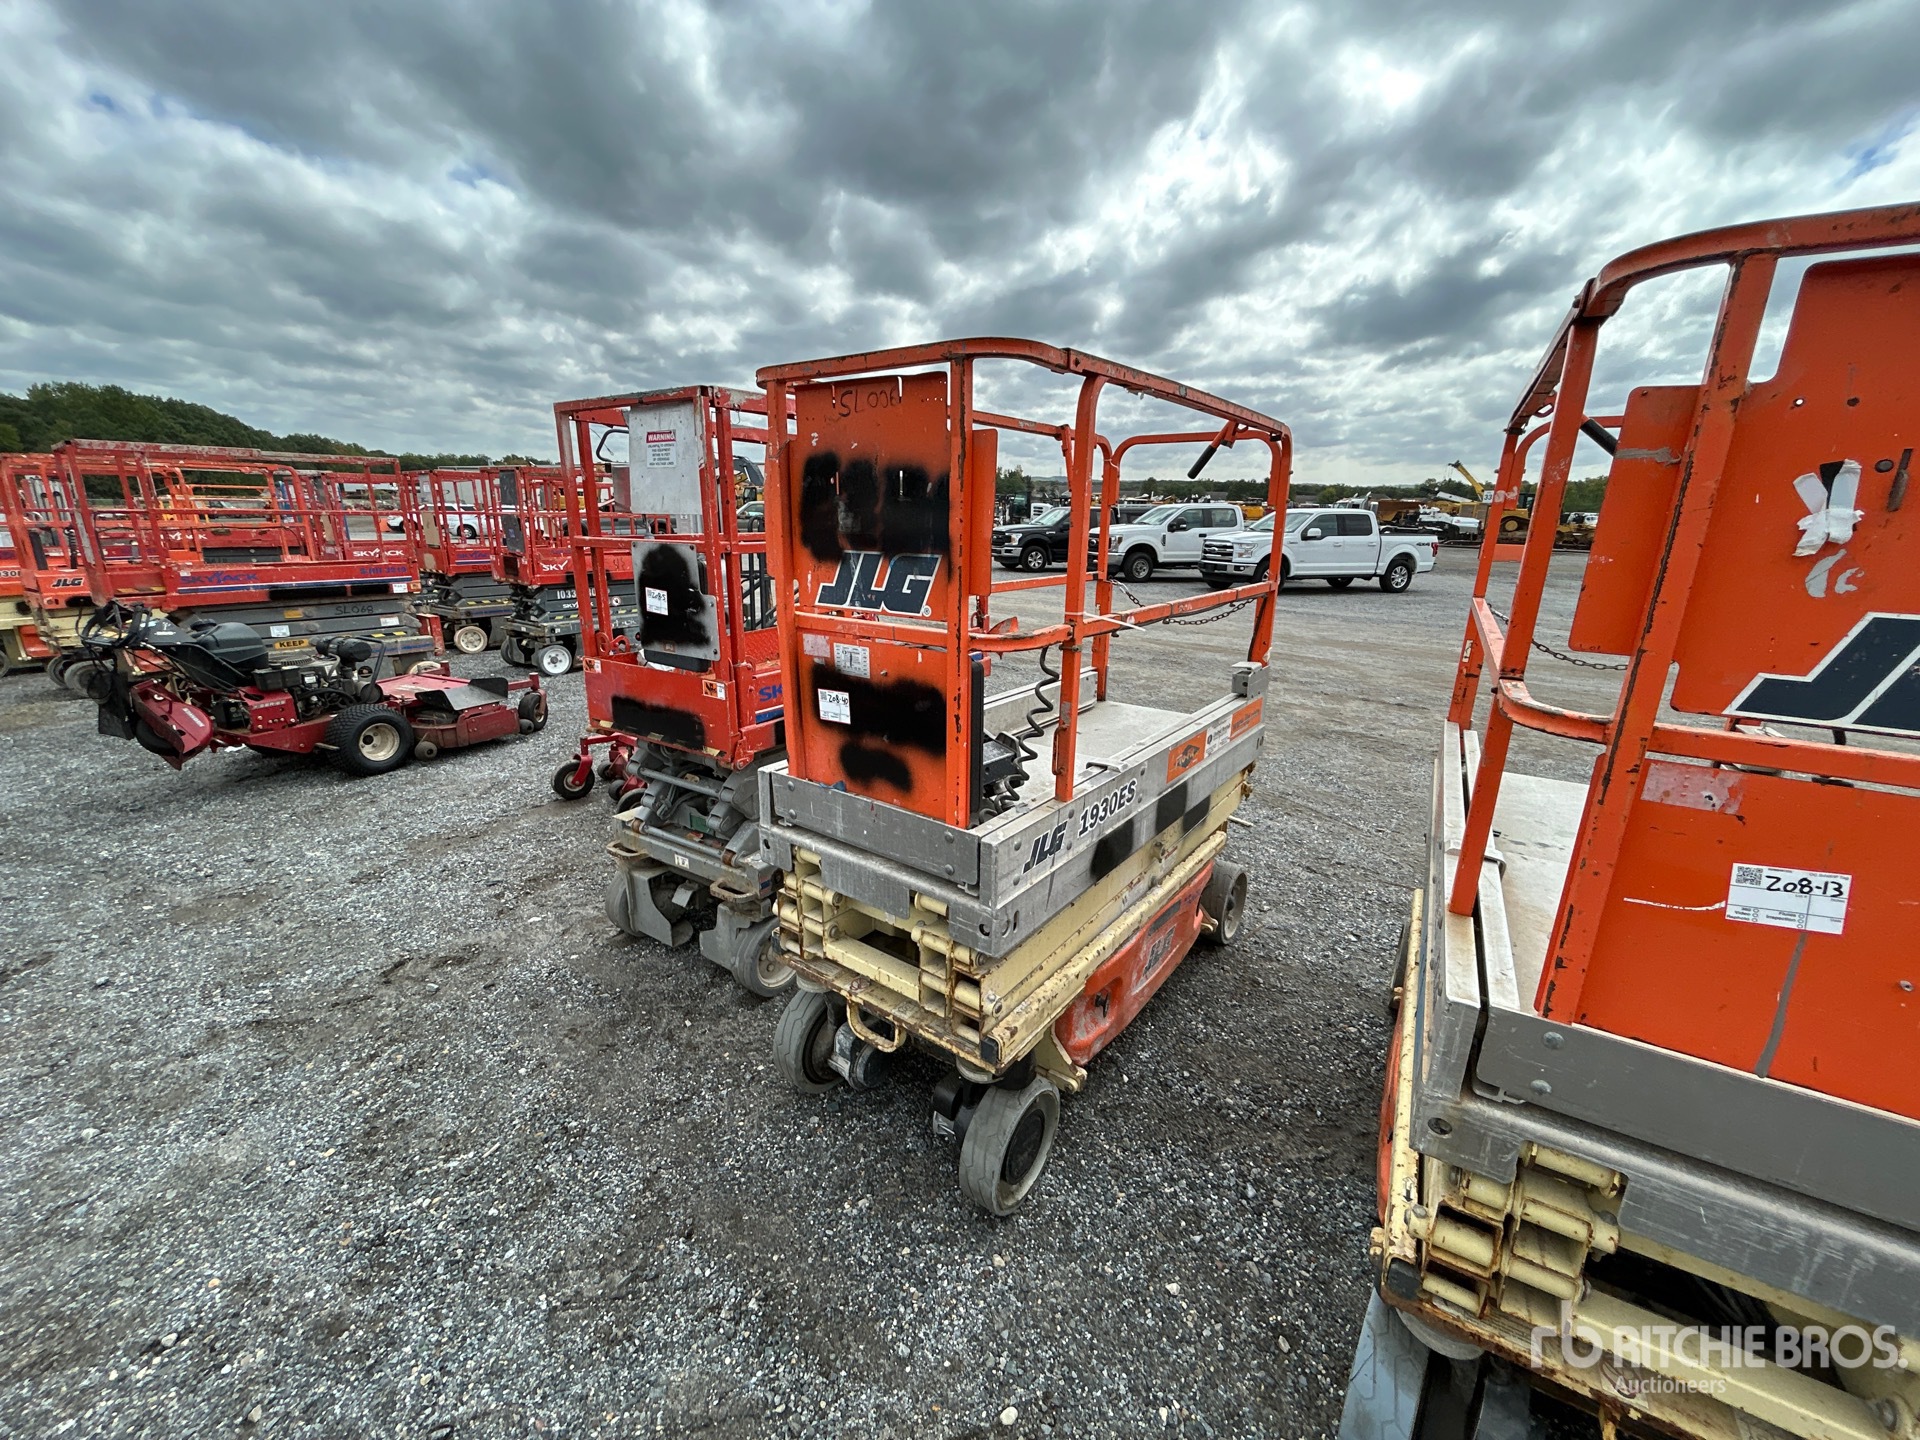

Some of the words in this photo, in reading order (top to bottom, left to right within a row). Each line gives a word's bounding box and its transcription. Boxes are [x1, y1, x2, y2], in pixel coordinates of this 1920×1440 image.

[648, 433, 675, 441] WARNING
[51, 578, 83, 588] JLG
[815, 550, 942, 616] JLG
[279, 640, 305, 648] KEEP
[1078, 778, 1138, 837] 1930ES
[1022, 821, 1068, 875] JLG
